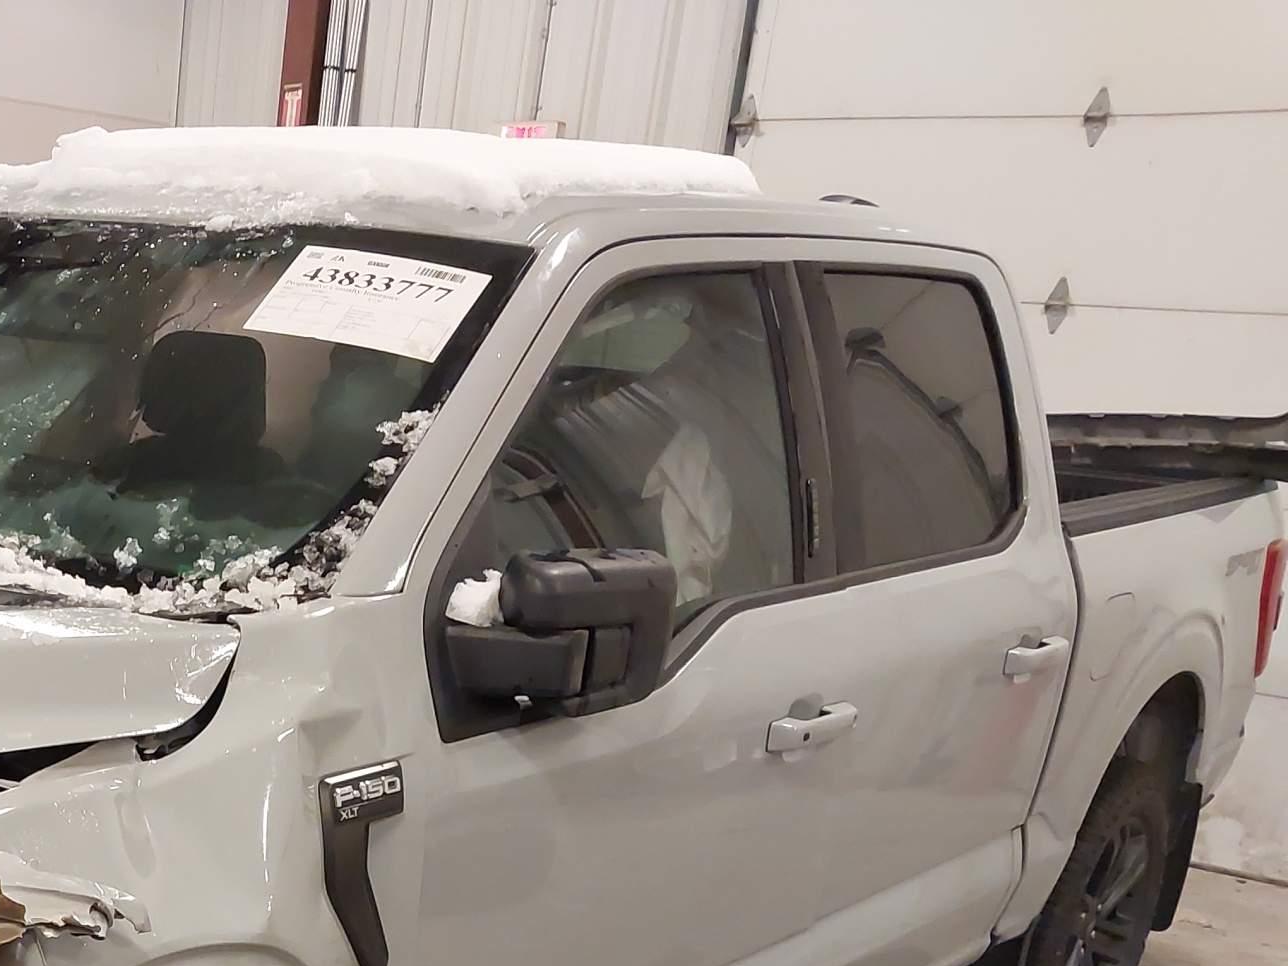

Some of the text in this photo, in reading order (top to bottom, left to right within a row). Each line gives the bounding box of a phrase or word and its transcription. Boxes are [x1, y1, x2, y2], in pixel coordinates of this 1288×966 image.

[302, 266, 454, 304] 43833777
[333, 775, 401, 807] F-150
[340, 807, 359, 821] XLT
